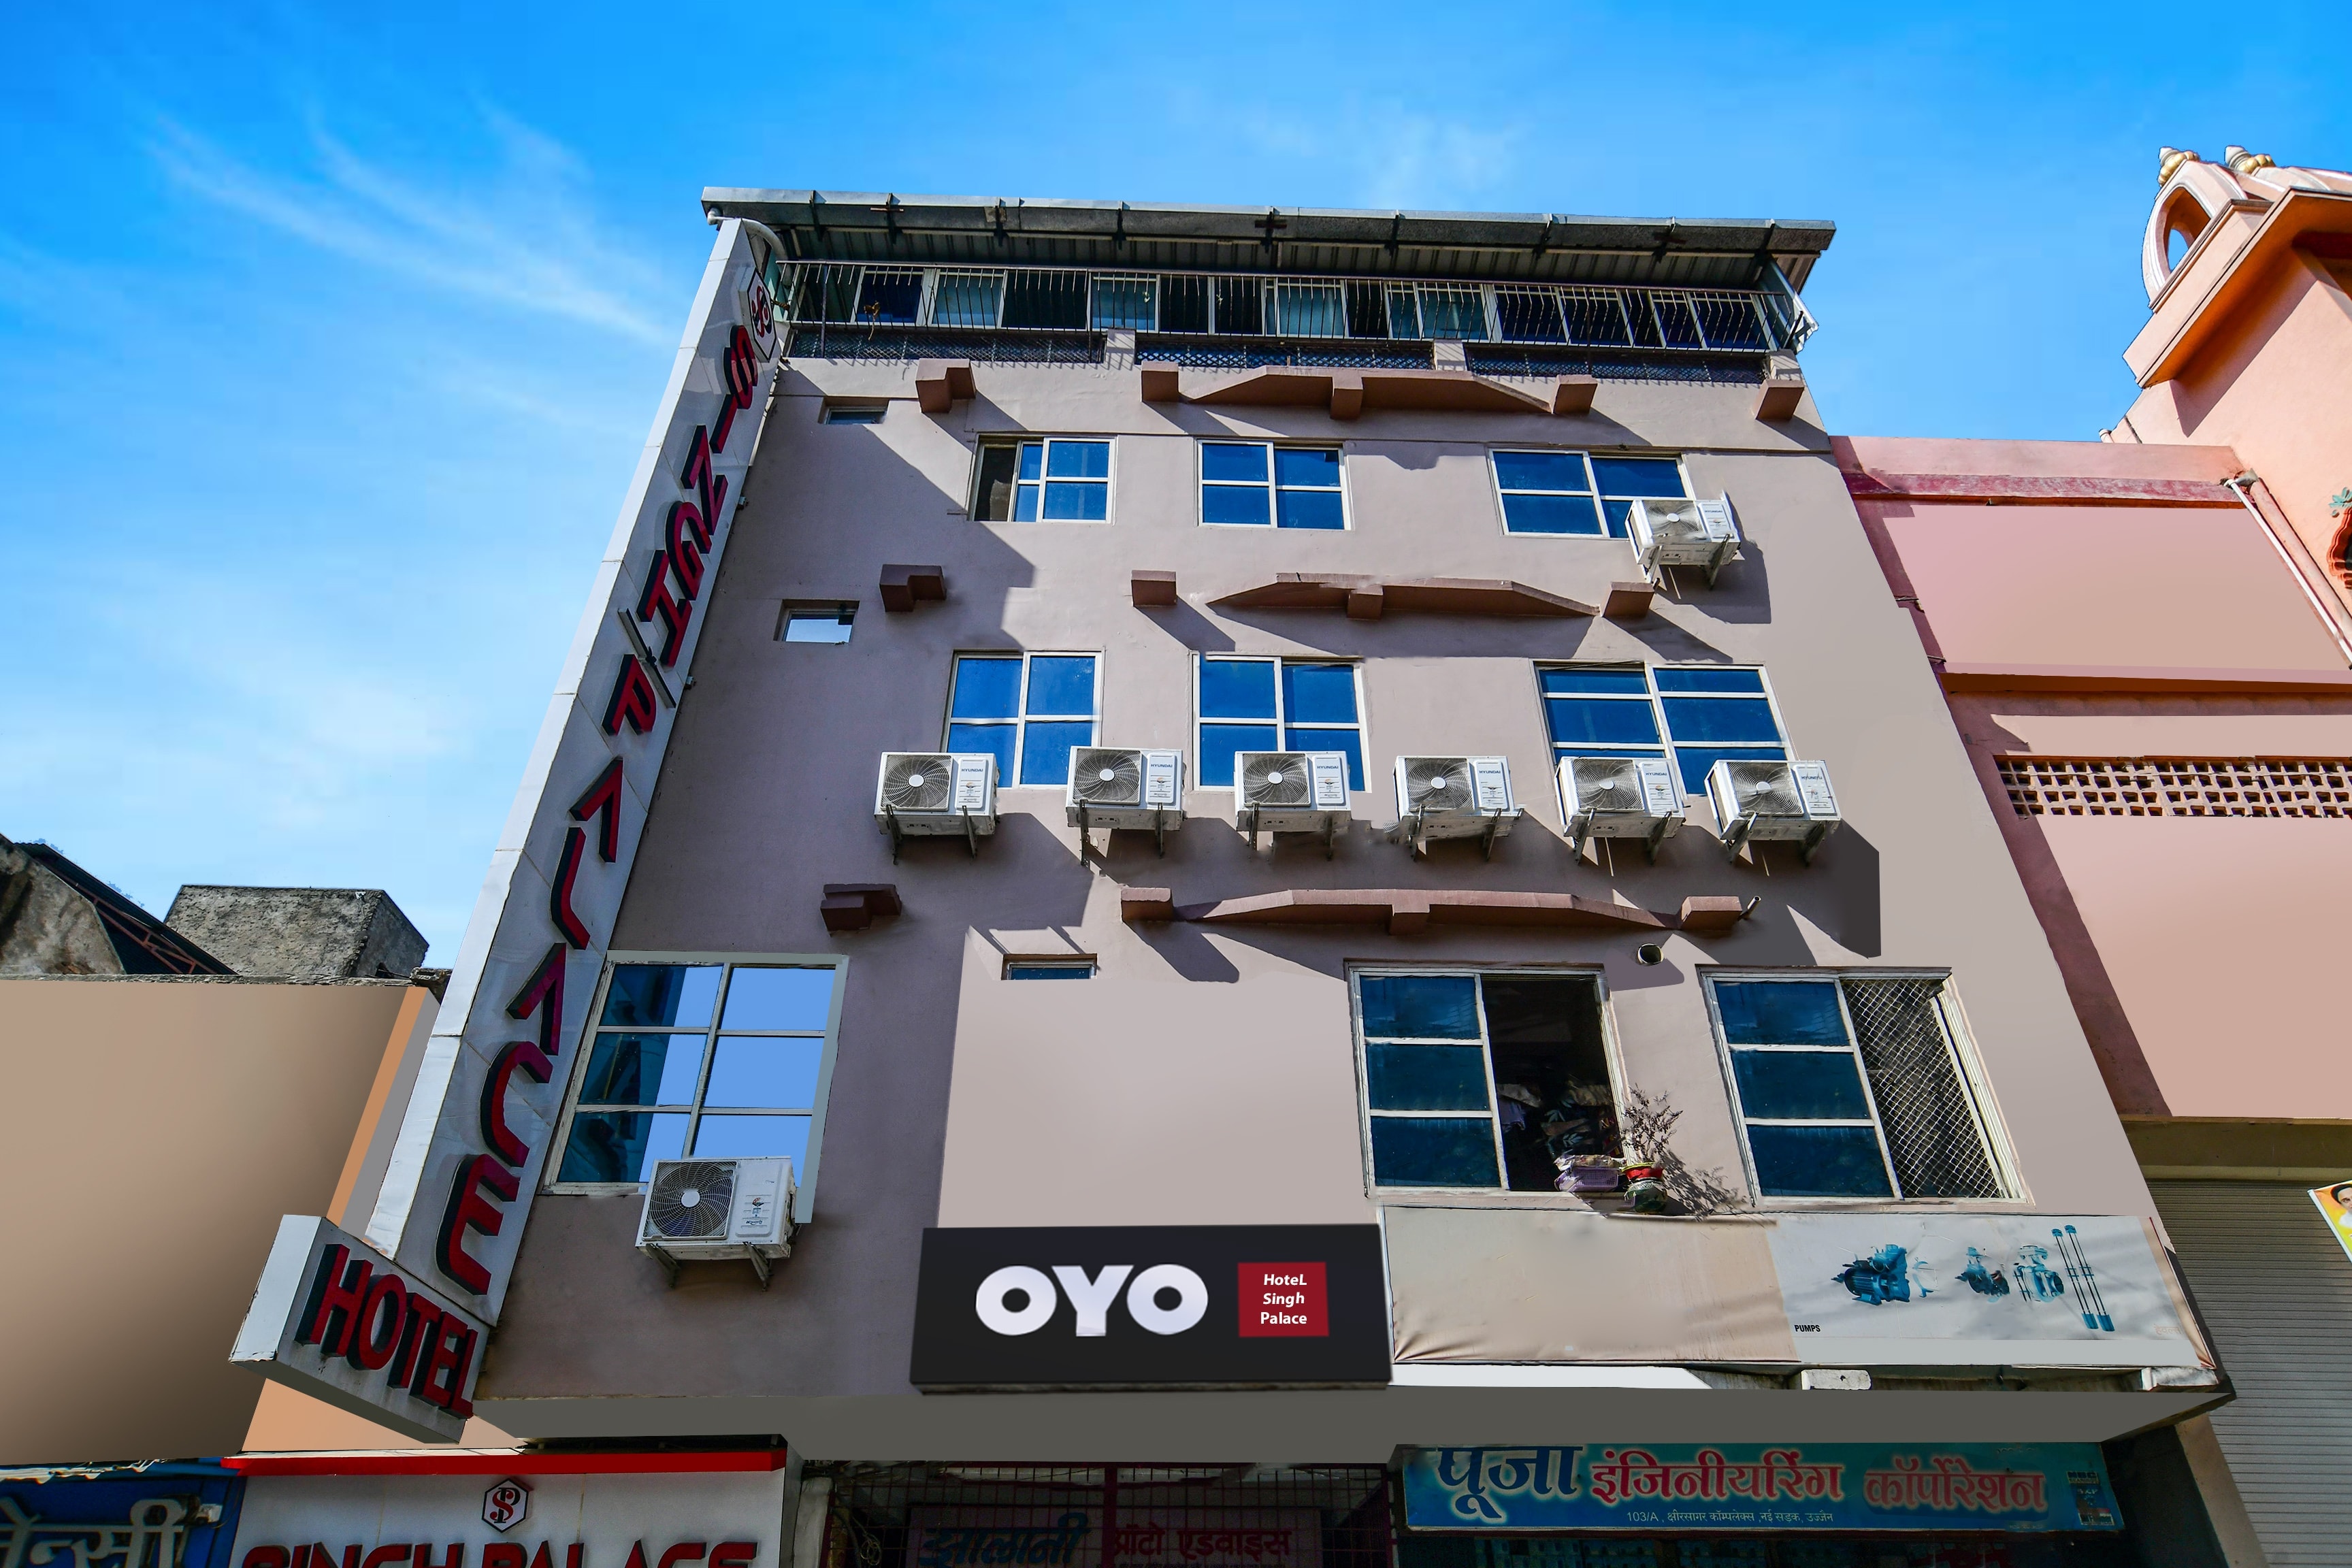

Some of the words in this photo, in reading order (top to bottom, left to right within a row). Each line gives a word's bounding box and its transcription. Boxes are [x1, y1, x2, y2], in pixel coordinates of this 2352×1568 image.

[637, 325, 758, 668] SINGH
[435, 654, 657, 1296] PALACE
[976, 1264, 1209, 1337] OYO
[1260, 1311, 1307, 1324] Palace
[1262, 1292, 1305, 1308] Singh
[294, 1244, 478, 1420] HOTEL
[1794, 1324, 1821, 1333] PUMPS
[1437, 1446, 1583, 1518] पूजा
[1591, 1450, 1843, 1503] इंजिनीयरिंग
[1865, 1458, 2045, 1509] कॉर्पोरेशन
[1627, 1511, 1659, 1522] 103/A
[1667, 1509, 1708, 1522] क्षीरसागर
[1709, 1509, 1755, 1522] कॉम्पलेक्स
[1805, 1509, 1834, 1522] उज्जैन
[1177, 1528, 1292, 1561] एडवाइस
